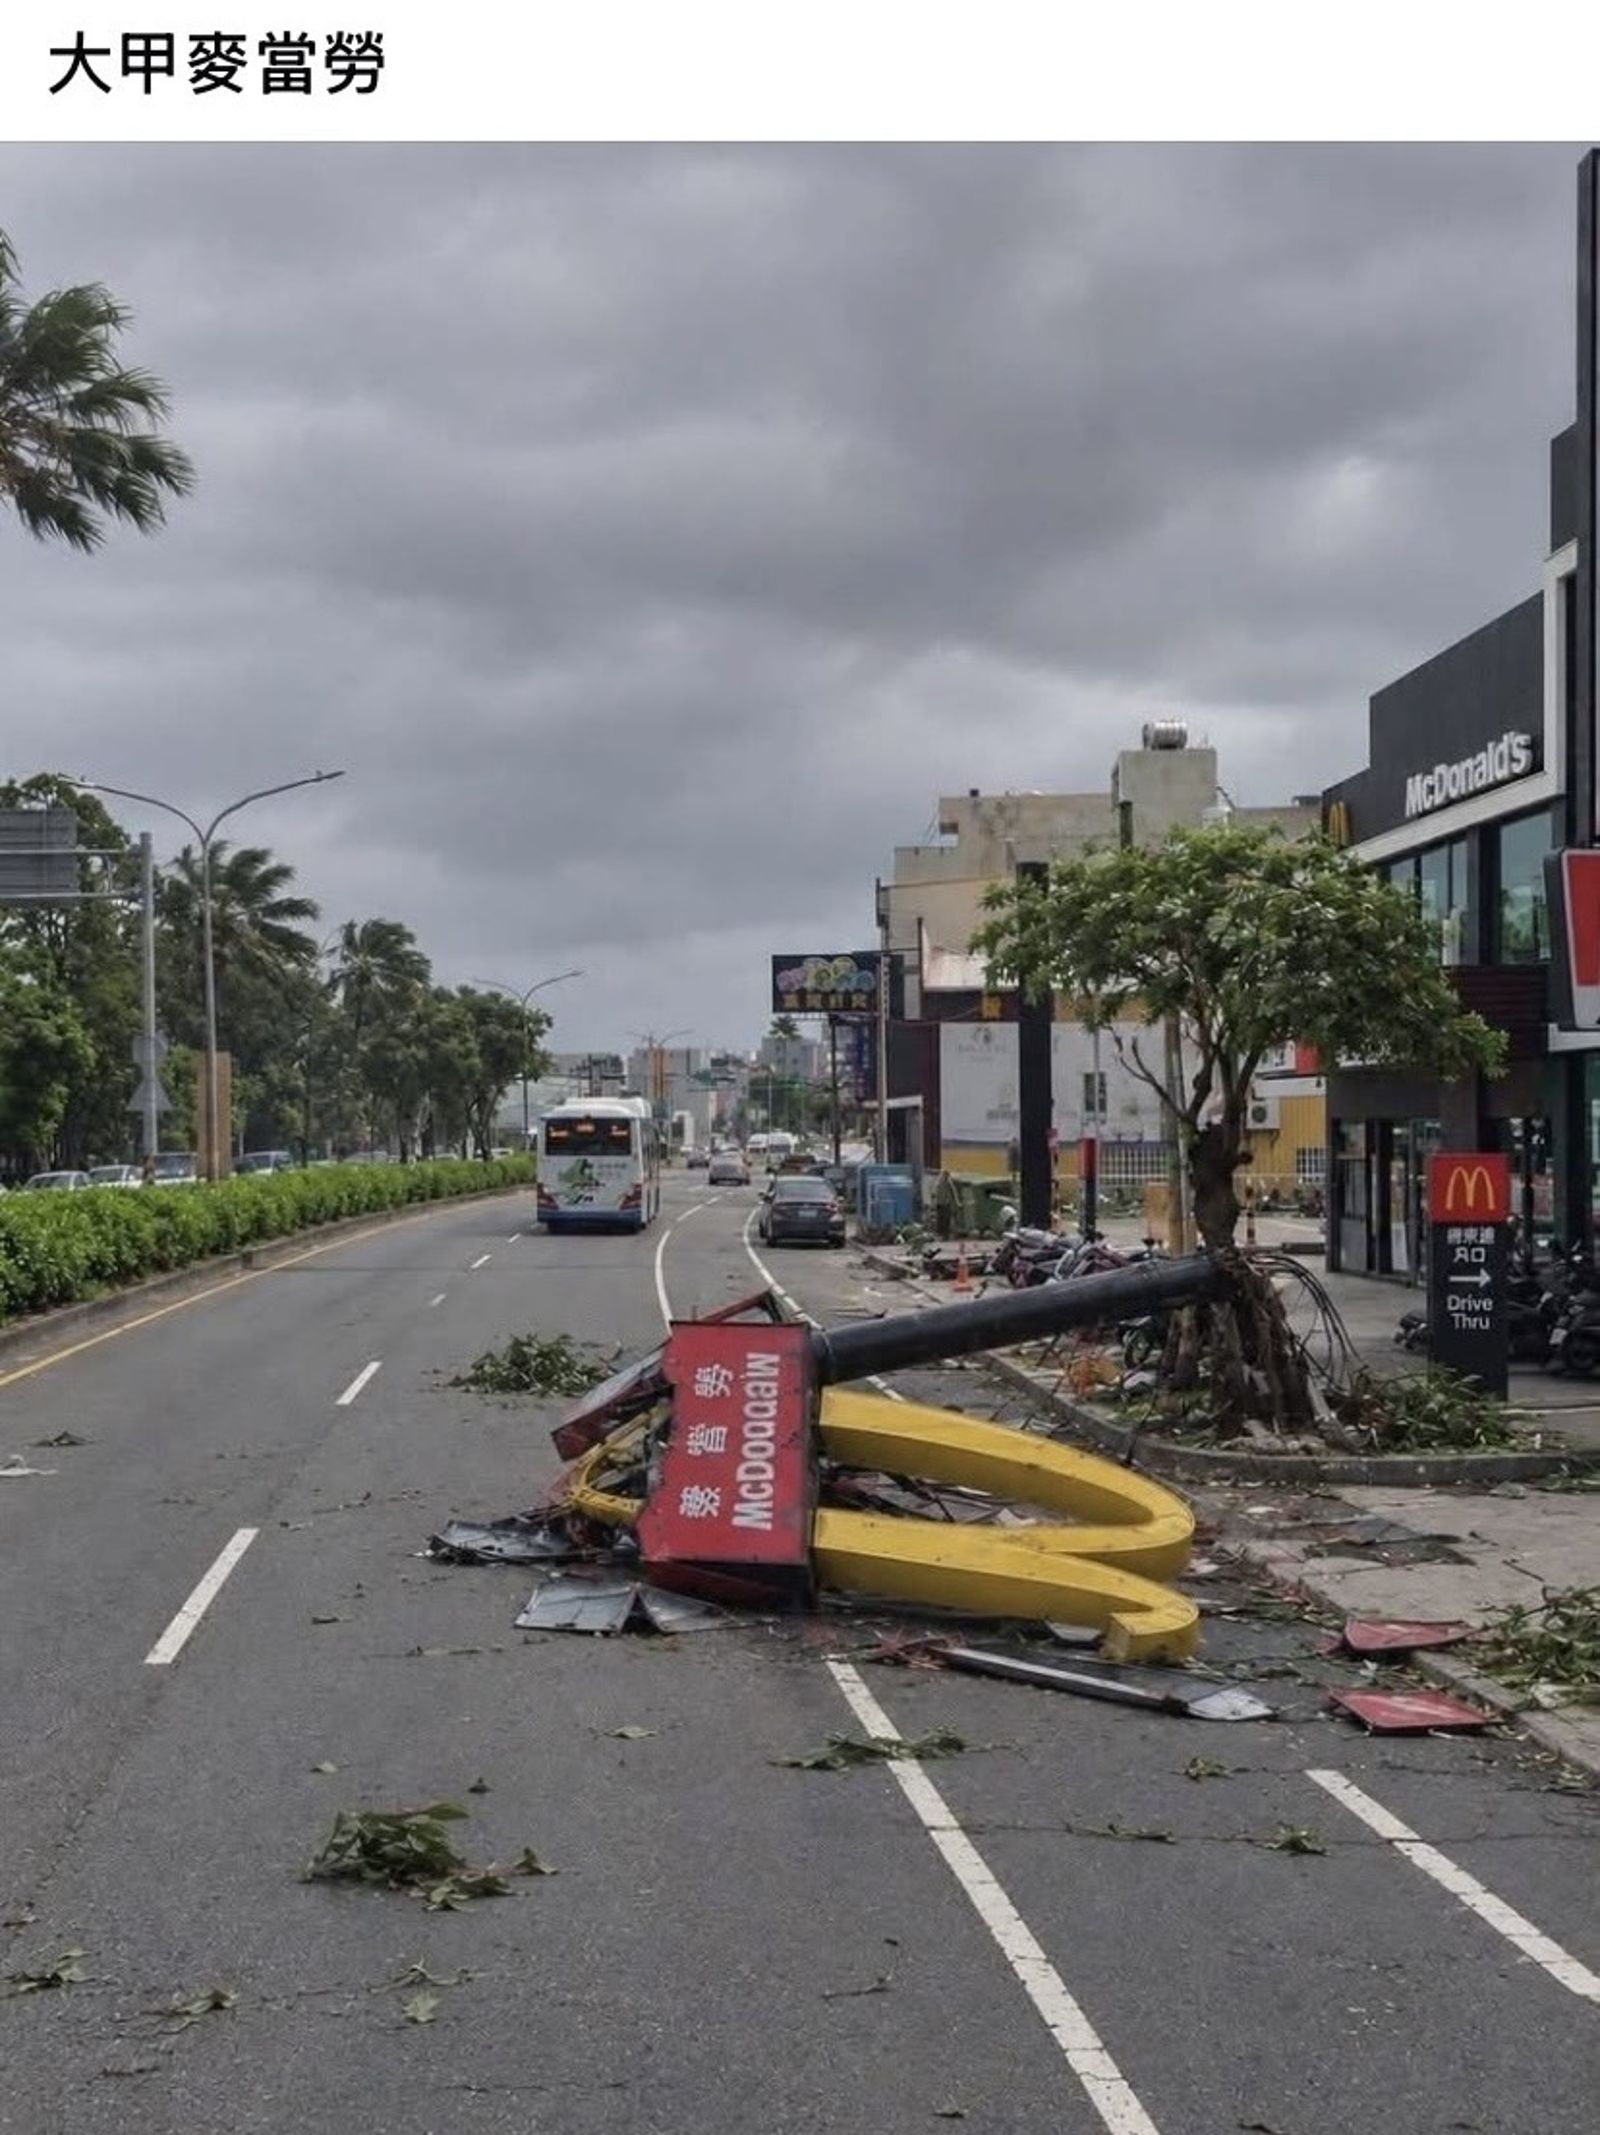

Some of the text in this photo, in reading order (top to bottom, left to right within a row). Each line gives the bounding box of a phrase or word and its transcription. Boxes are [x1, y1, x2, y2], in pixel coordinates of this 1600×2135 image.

[1404, 730, 1533, 818] McDonald's
[1446, 1293, 1494, 1312] Drive
[1451, 1312, 1491, 1331] Thru
